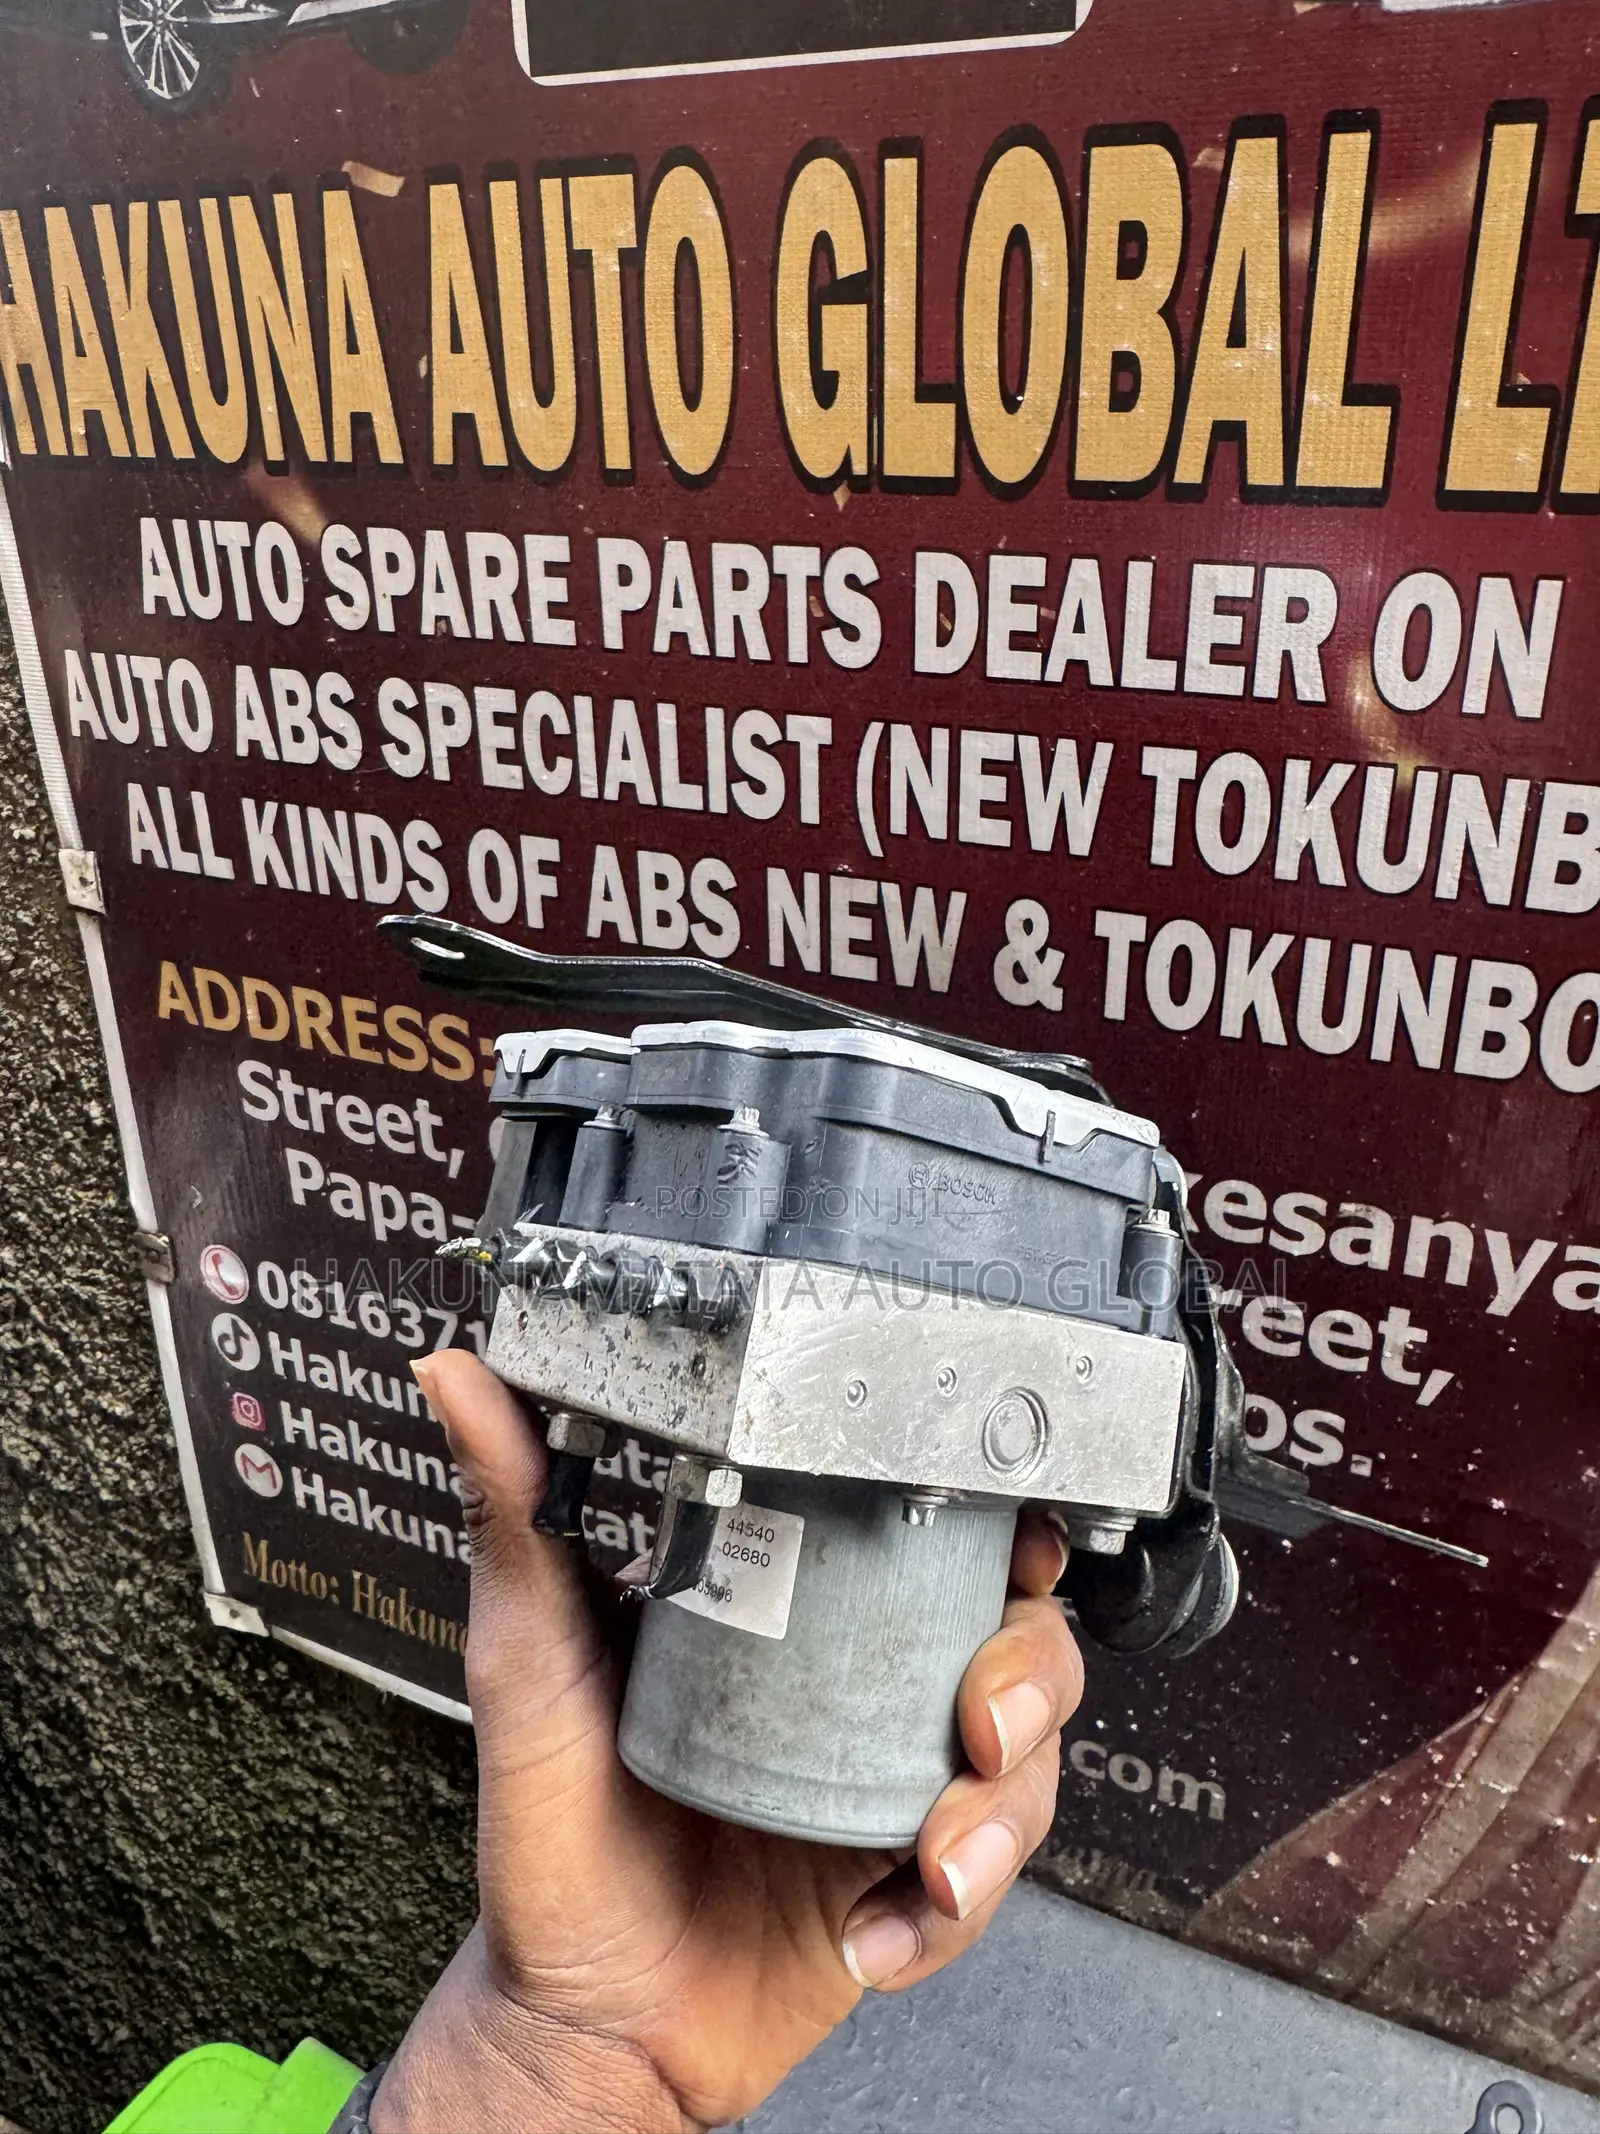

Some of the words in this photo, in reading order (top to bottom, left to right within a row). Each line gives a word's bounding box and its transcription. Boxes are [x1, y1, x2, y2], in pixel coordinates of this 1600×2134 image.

[0, 191, 403, 464] HAKUNA
[430, 166, 733, 475] AUTO
[777, 131, 1392, 490] GLOBAL
[140, 517, 302, 626] AUTO
[321, 524, 577, 647] SPARE
[599, 537, 882, 669] PARTS
[914, 551, 1338, 703] DEALER
[1374, 572, 1564, 719] ON
[64, 649, 211, 752] AUTO
[236, 665, 362, 771] ABS
[379, 677, 832, 825] SPECIALIST
[857, 722, 1115, 858] (NEW
[1142, 746, 1600, 914] TOKUNB
[127, 784, 235, 881] ALL
[241, 799, 450, 912] KINDS
[468, 828, 560, 929] OF
[586, 846, 741, 958] ABS
[767, 867, 967, 993] NEW
[994, 899, 1063, 1011] &
[1095, 910, 1600, 1094] TOKUNBO
[158, 960, 497, 1088] ADDRESS:
[236, 1060, 465, 1179] Street,
[286, 1148, 476, 1242] Papa-
[242, 1531, 340, 1605] Motto:
[721, 1541, 771, 1568] 02680
[726, 1517, 775, 1543] 44540
